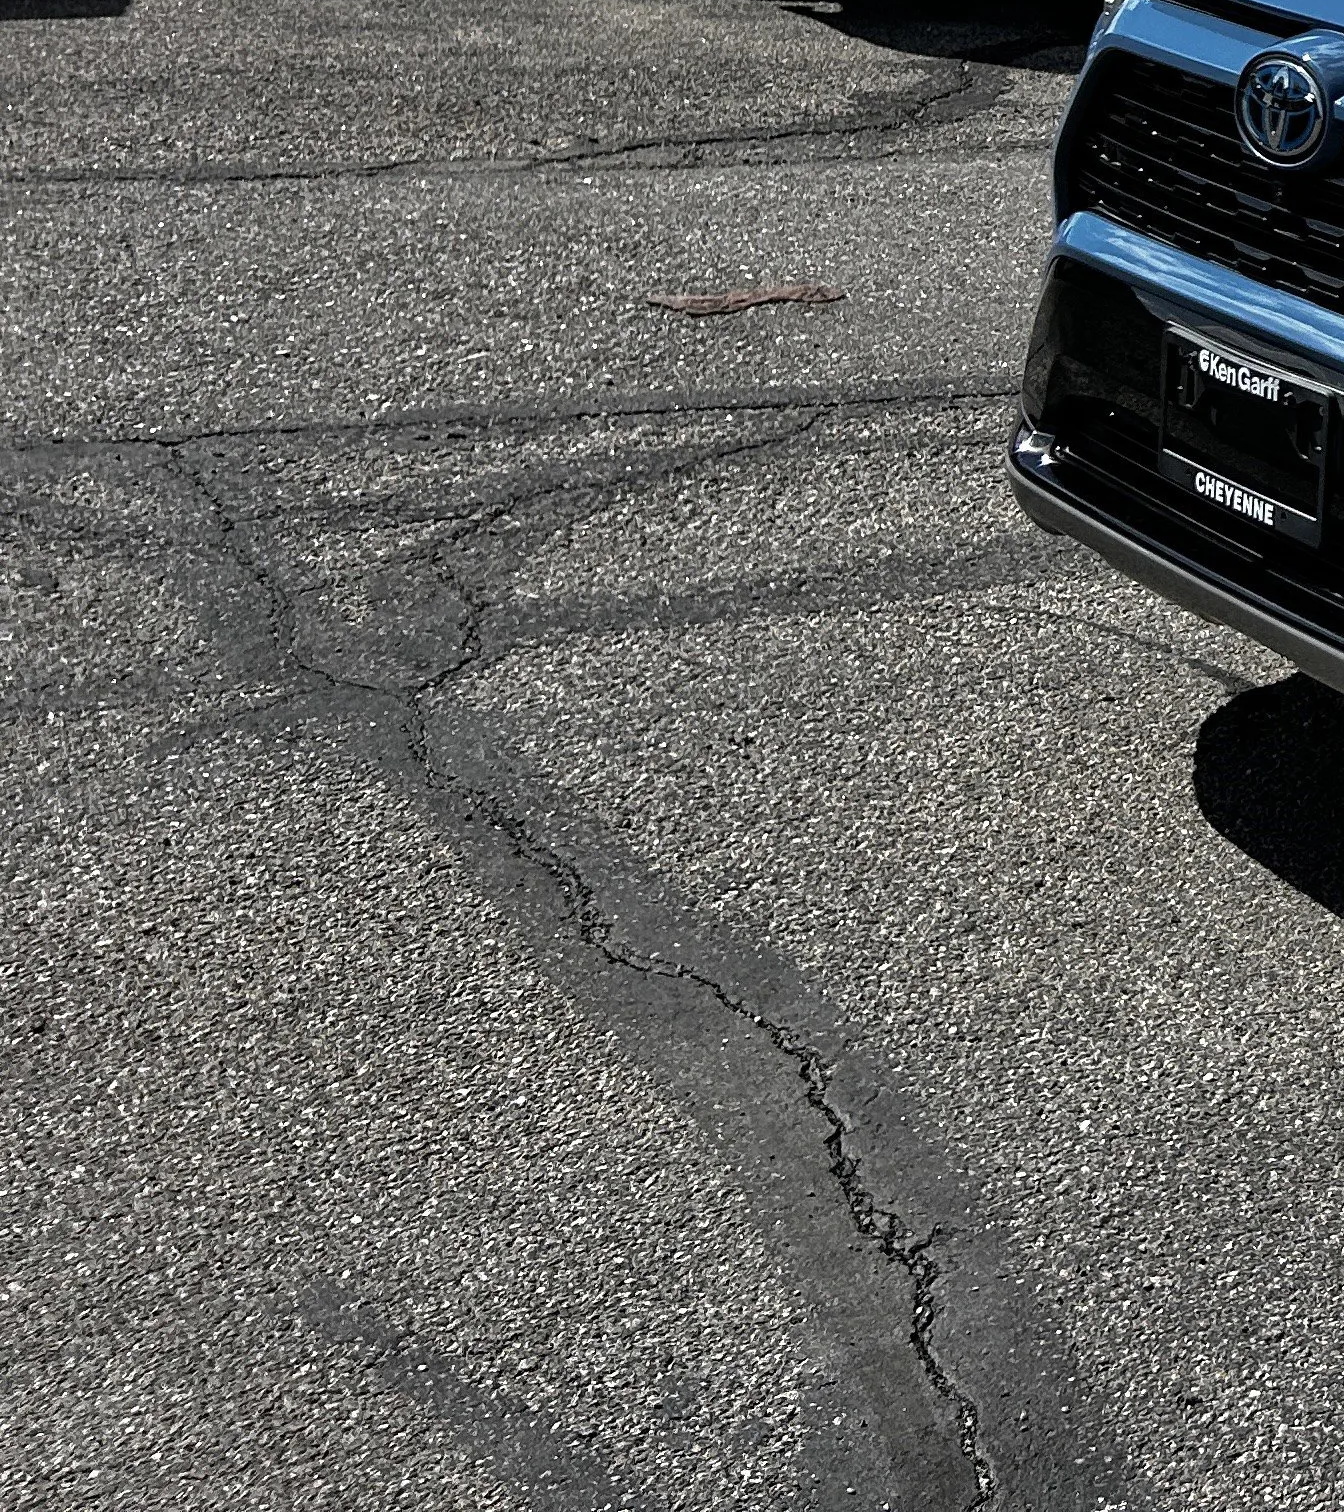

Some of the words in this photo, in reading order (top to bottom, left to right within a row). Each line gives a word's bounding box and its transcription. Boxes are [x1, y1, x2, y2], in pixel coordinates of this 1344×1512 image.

[1209, 352, 1237, 387] Ken
[1238, 367, 1280, 402] Garff
[1195, 472, 1274, 526] CHEYENNE
